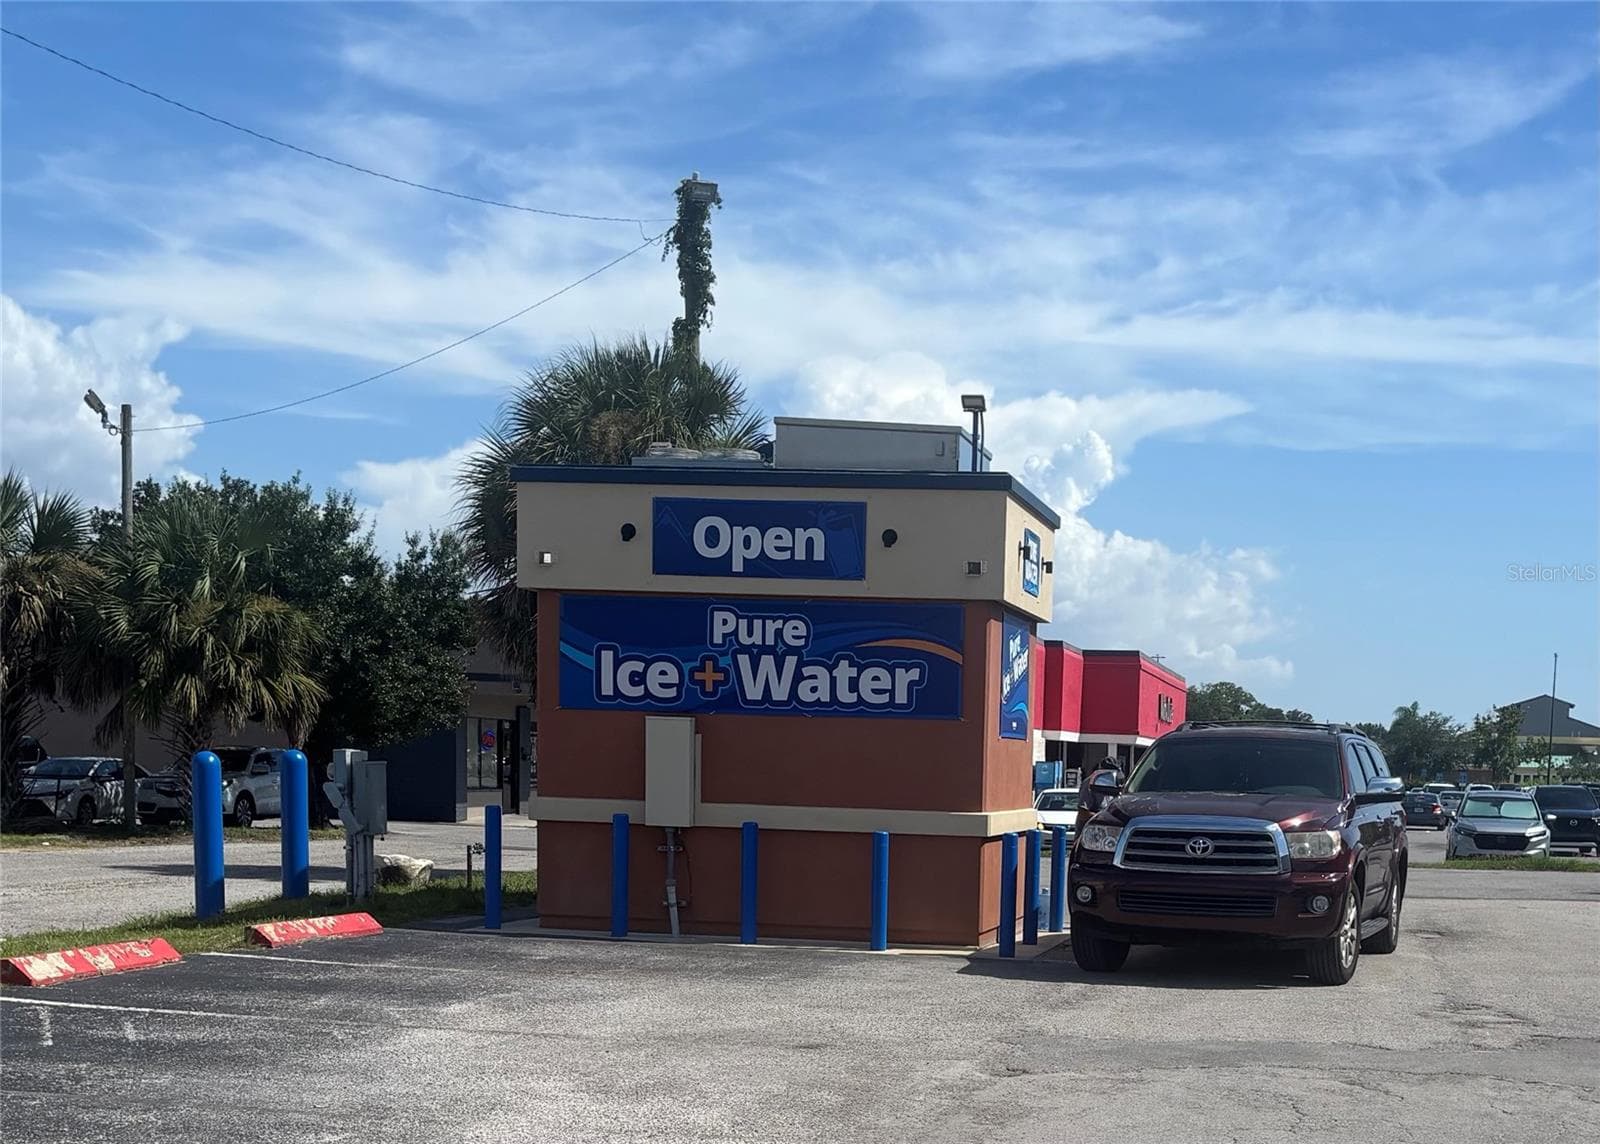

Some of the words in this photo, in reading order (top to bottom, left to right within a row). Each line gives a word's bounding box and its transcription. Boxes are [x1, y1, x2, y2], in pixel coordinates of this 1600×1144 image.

[693, 516, 826, 572] Open
[712, 611, 808, 647] Pure
[600, 650, 680, 699] Ice
[736, 654, 921, 705] Water
